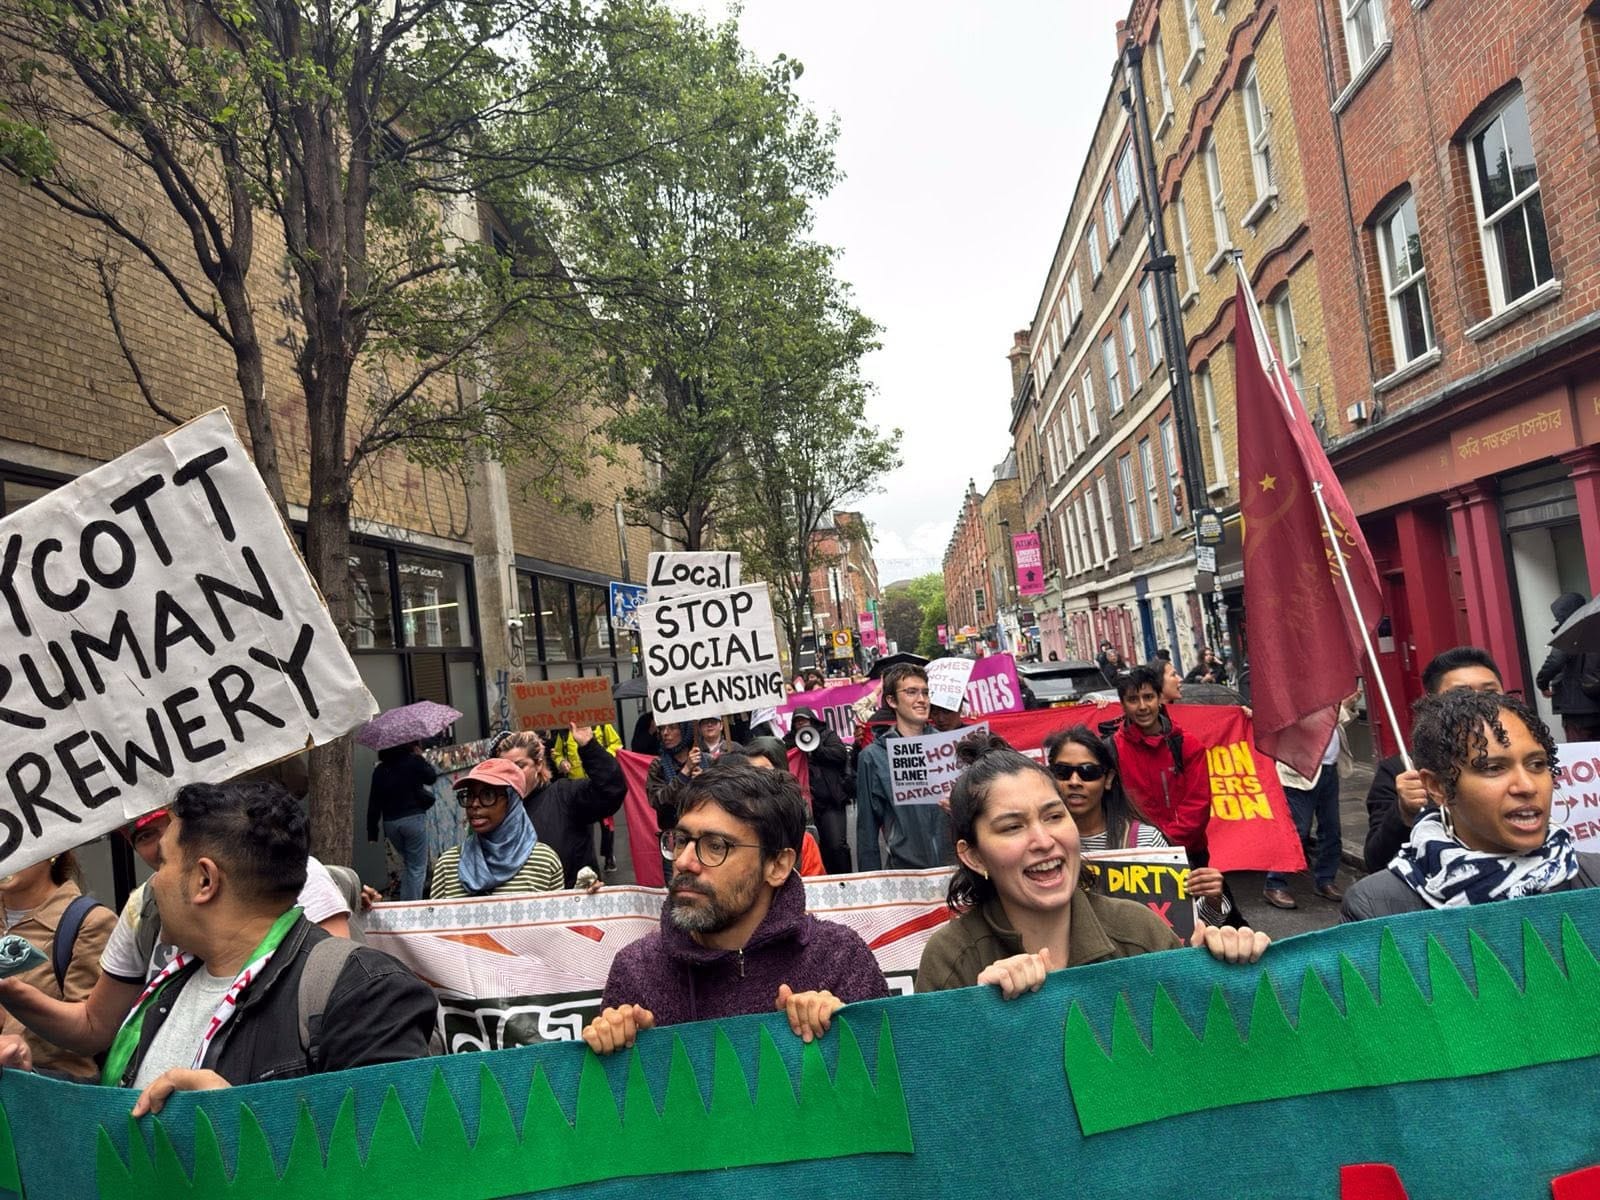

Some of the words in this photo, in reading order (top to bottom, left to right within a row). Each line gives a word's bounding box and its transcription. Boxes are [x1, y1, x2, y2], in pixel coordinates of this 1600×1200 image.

[651, 553, 732, 589] Local
[655, 591, 753, 639] STOP
[648, 629, 774, 677] SOCIAL
[515, 684, 556, 700] BUILD
[560, 678, 608, 695] HOMES
[652, 671, 784, 713] CLEANSING
[929, 683, 962, 695] TRES
[550, 695, 579, 708] NOT
[522, 713, 556, 728] DATA
[558, 707, 616, 725] CENTRES
[892, 743, 924, 756] SAVE
[892, 755, 927, 769] BRICK
[893, 769, 929, 781] LANE!
[1210, 792, 1275, 821] ON
[1107, 864, 1191, 900] DIRTY
